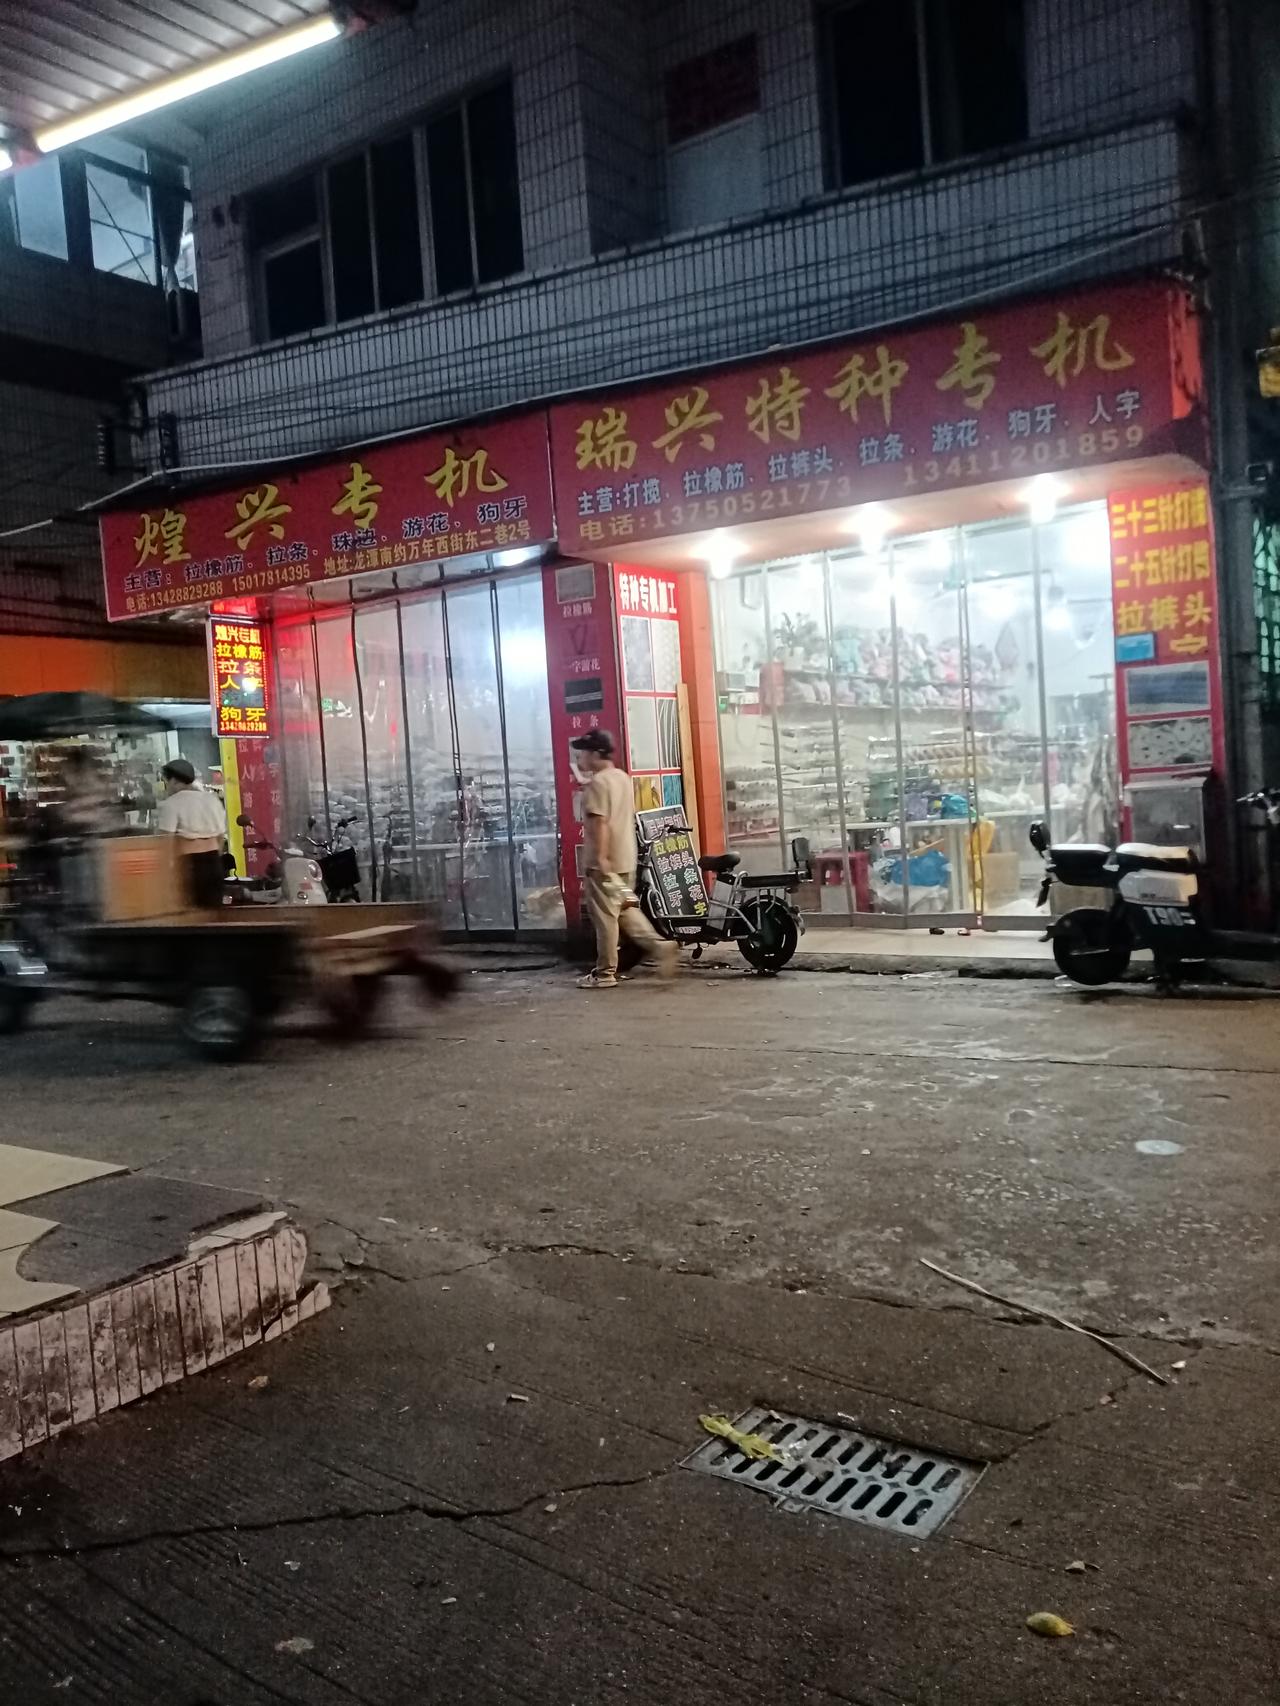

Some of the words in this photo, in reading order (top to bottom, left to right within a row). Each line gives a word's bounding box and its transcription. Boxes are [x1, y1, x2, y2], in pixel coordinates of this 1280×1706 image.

[575, 311, 1136, 473] 瑞兴特种专机
[904, 426, 1145, 488] 13411201859
[133, 447, 509, 568] 煌兴专机
[232, 563, 311, 592] 15017814395
[1117, 591, 1212, 634] 拉裤头
[220, 706, 267, 722] 狗牙
